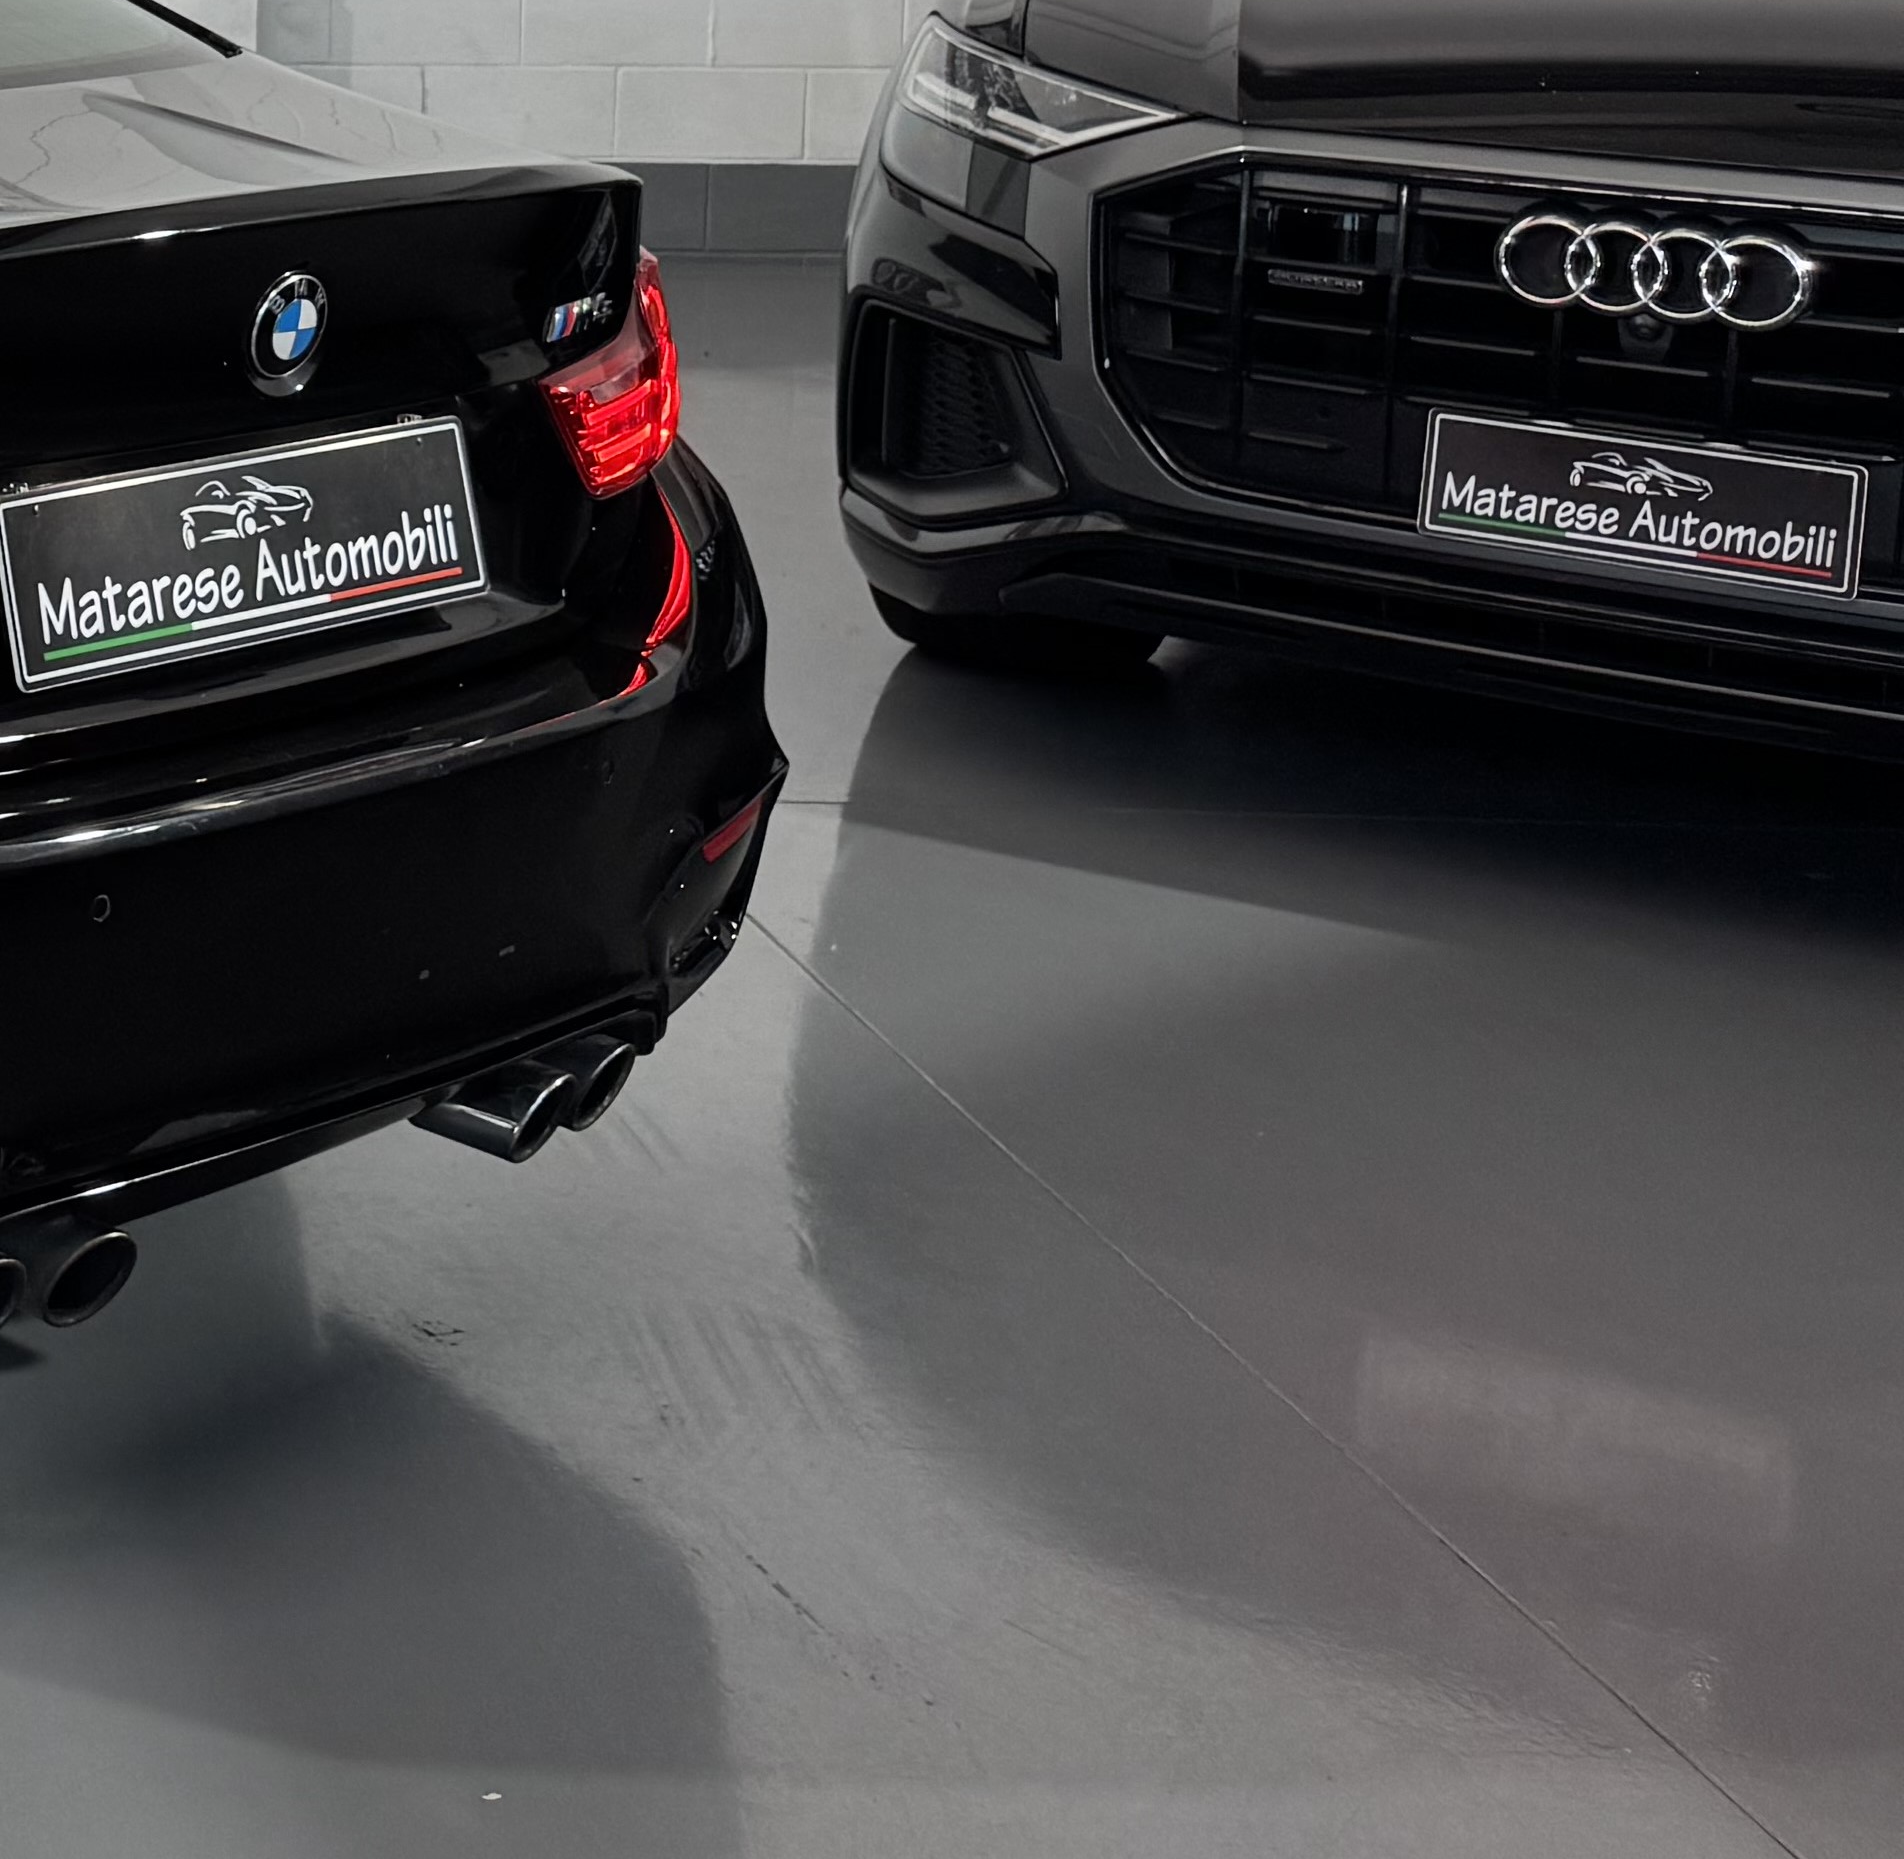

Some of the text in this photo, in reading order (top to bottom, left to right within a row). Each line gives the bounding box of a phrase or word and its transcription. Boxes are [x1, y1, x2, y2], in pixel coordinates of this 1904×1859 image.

[37, 502, 459, 646] Matarese Automobili
[1441, 471, 1838, 569] Matarese Automobili
